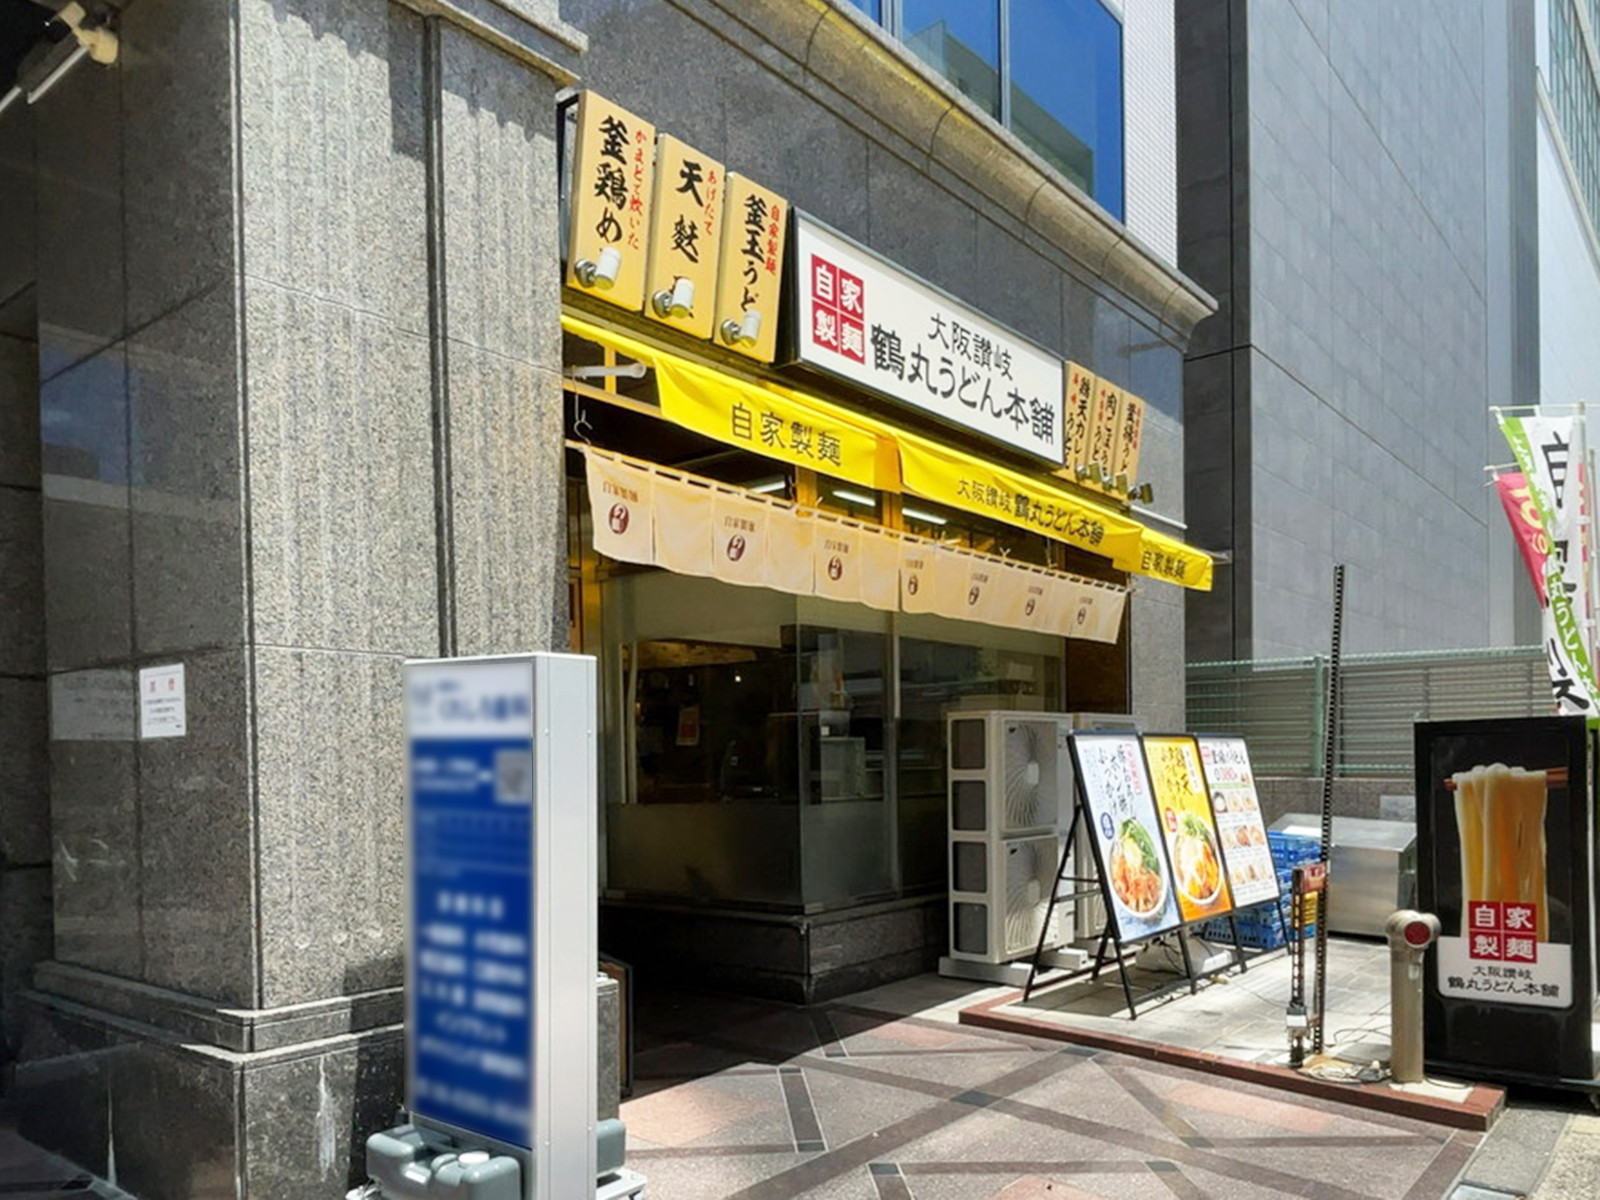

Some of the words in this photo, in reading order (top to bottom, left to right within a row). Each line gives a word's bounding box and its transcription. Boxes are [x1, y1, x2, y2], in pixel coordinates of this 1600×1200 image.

[594, 115, 630, 252] 釜鶏め
[628, 130, 648, 250] かまどで炊いた
[703, 170, 717, 235] あげたて
[741, 195, 767, 312] 釜玉うど
[927, 312, 1013, 382] 大阪讃岐
[869, 323, 1056, 445] 鶴丸うどん本舗
[730, 401, 842, 467] 自家製麺
[957, 479, 1013, 514] 大阪讃岐
[1013, 493, 1105, 546] 鶴丸うどん本舗
[1446, 975, 1560, 998] 鶴丸うどん本舗
[1472, 965, 1534, 981] 大阪讃岐
